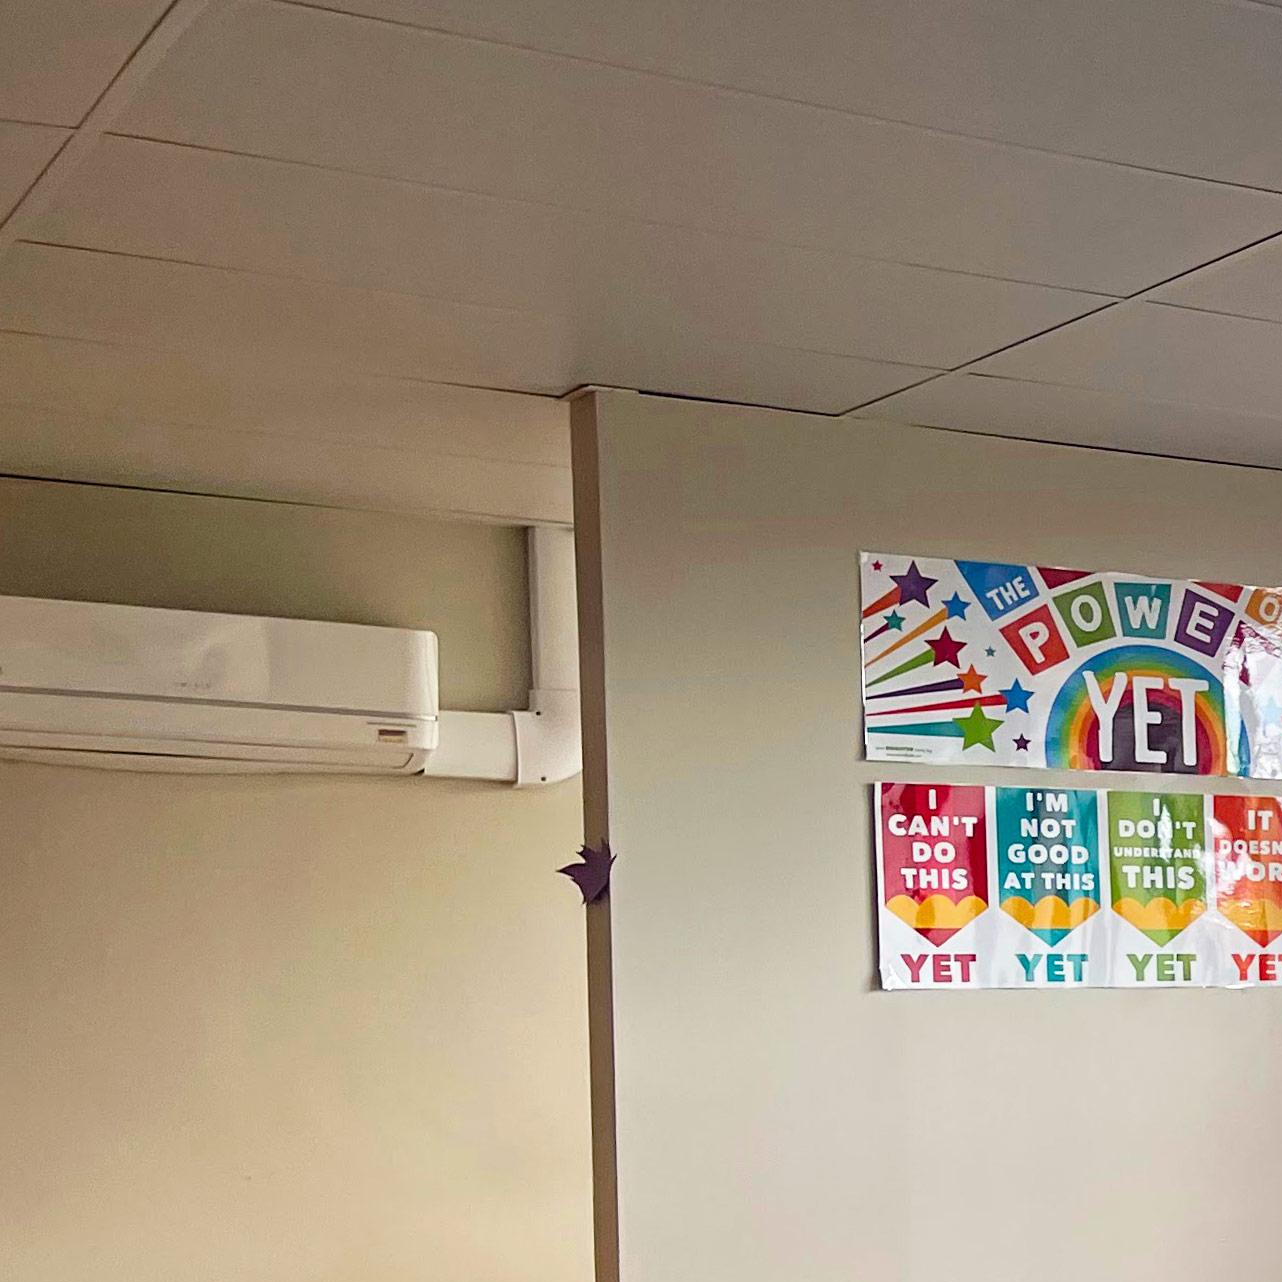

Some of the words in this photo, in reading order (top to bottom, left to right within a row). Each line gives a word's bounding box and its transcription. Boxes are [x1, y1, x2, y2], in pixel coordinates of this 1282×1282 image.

[985, 575, 1031, 613] THE
[1019, 592, 1222, 664] POWE
[1082, 670, 1210, 767] YET
[928, 789, 936, 809] I
[1026, 792, 1068, 812] I'M
[1153, 798, 1159, 817] I
[889, 813, 977, 837] CAN'T
[1021, 819, 1076, 838] NOT
[1247, 810, 1273, 831] IT
[912, 842, 955, 863] DO
[1007, 844, 1089, 865] GOOD
[900, 867, 968, 891] THIS
[1003, 872, 1035, 890] AT
[1040, 872, 1094, 891] THIS
[1122, 866, 1194, 890] THIS
[900, 953, 976, 983] YET
[1015, 953, 1088, 983] YET
[1127, 953, 1197, 983] YET
